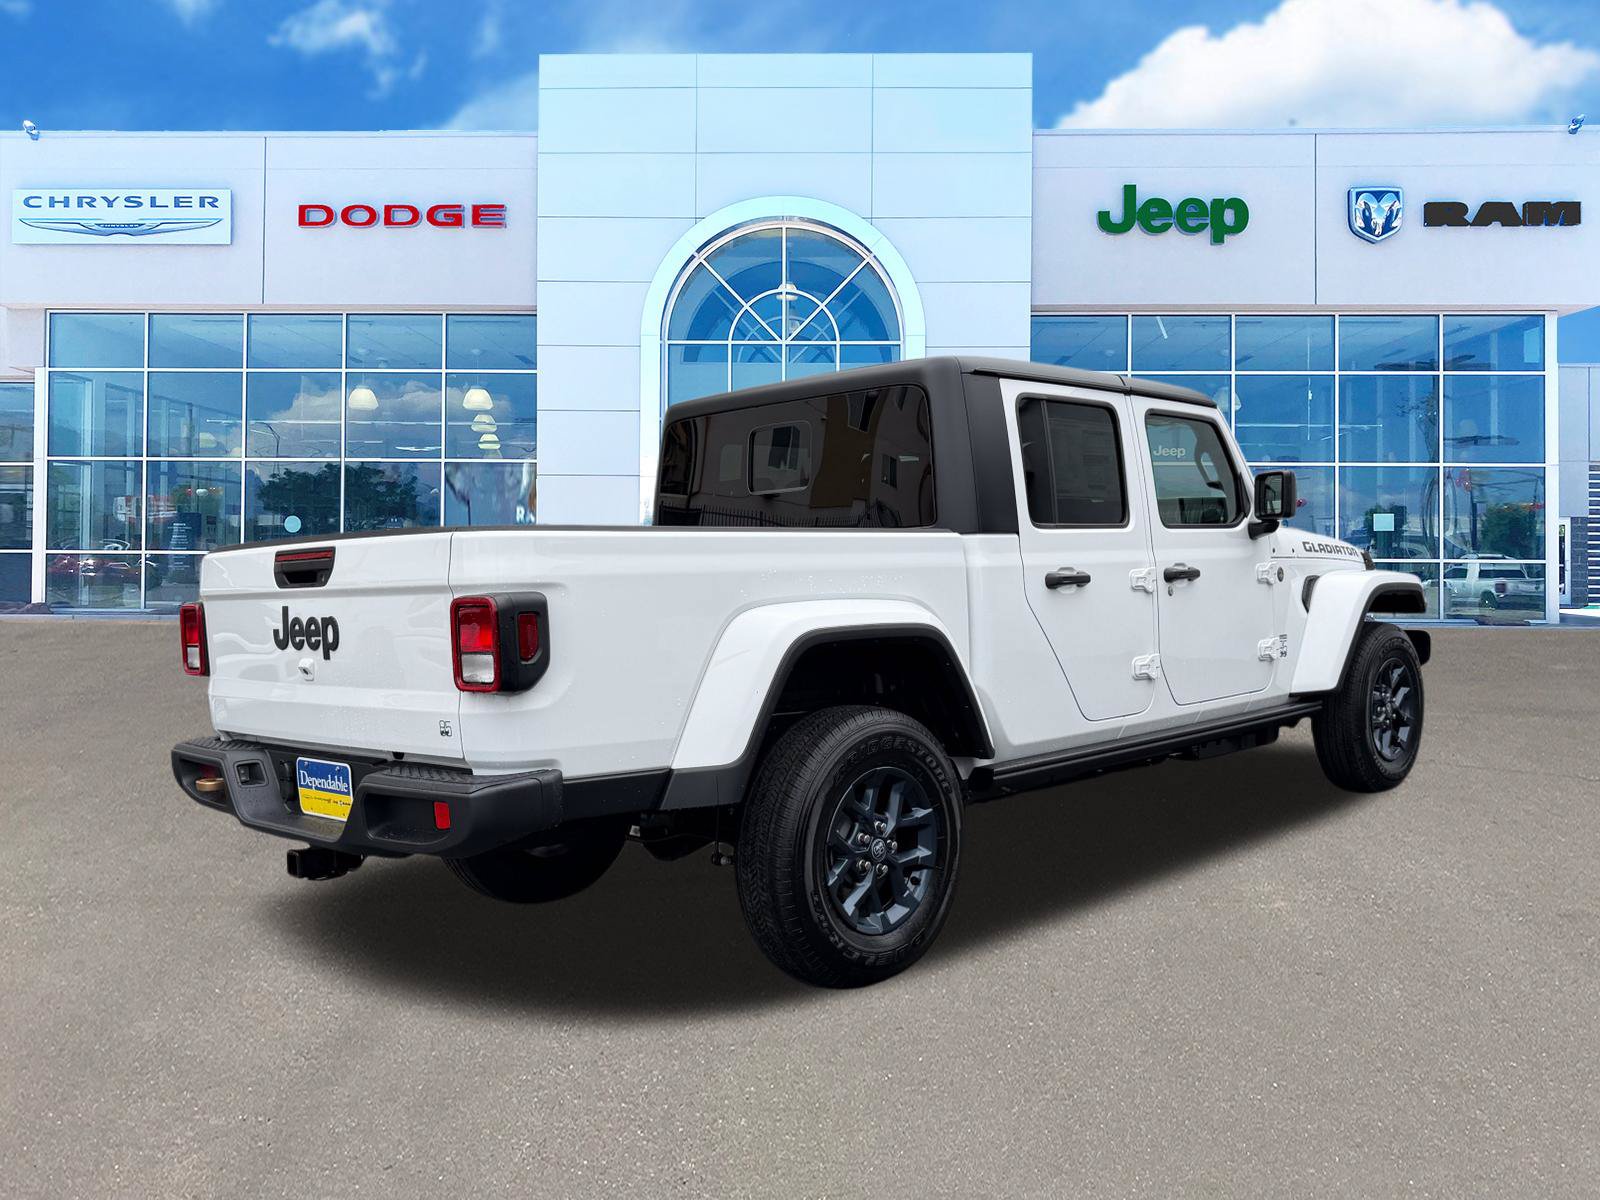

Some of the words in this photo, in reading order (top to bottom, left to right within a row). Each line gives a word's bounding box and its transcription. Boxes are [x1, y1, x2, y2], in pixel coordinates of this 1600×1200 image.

[23, 195, 219, 209] CHRYSLER
[298, 204, 507, 229] DODGE
[1097, 184, 1249, 245] Jeep
[1423, 201, 1582, 228] RAM
[1153, 444, 1186, 459] Jeep
[1301, 541, 1359, 557] GLADIATOR
[273, 605, 340, 661] Jeep
[299, 770, 349, 793] Dependable
